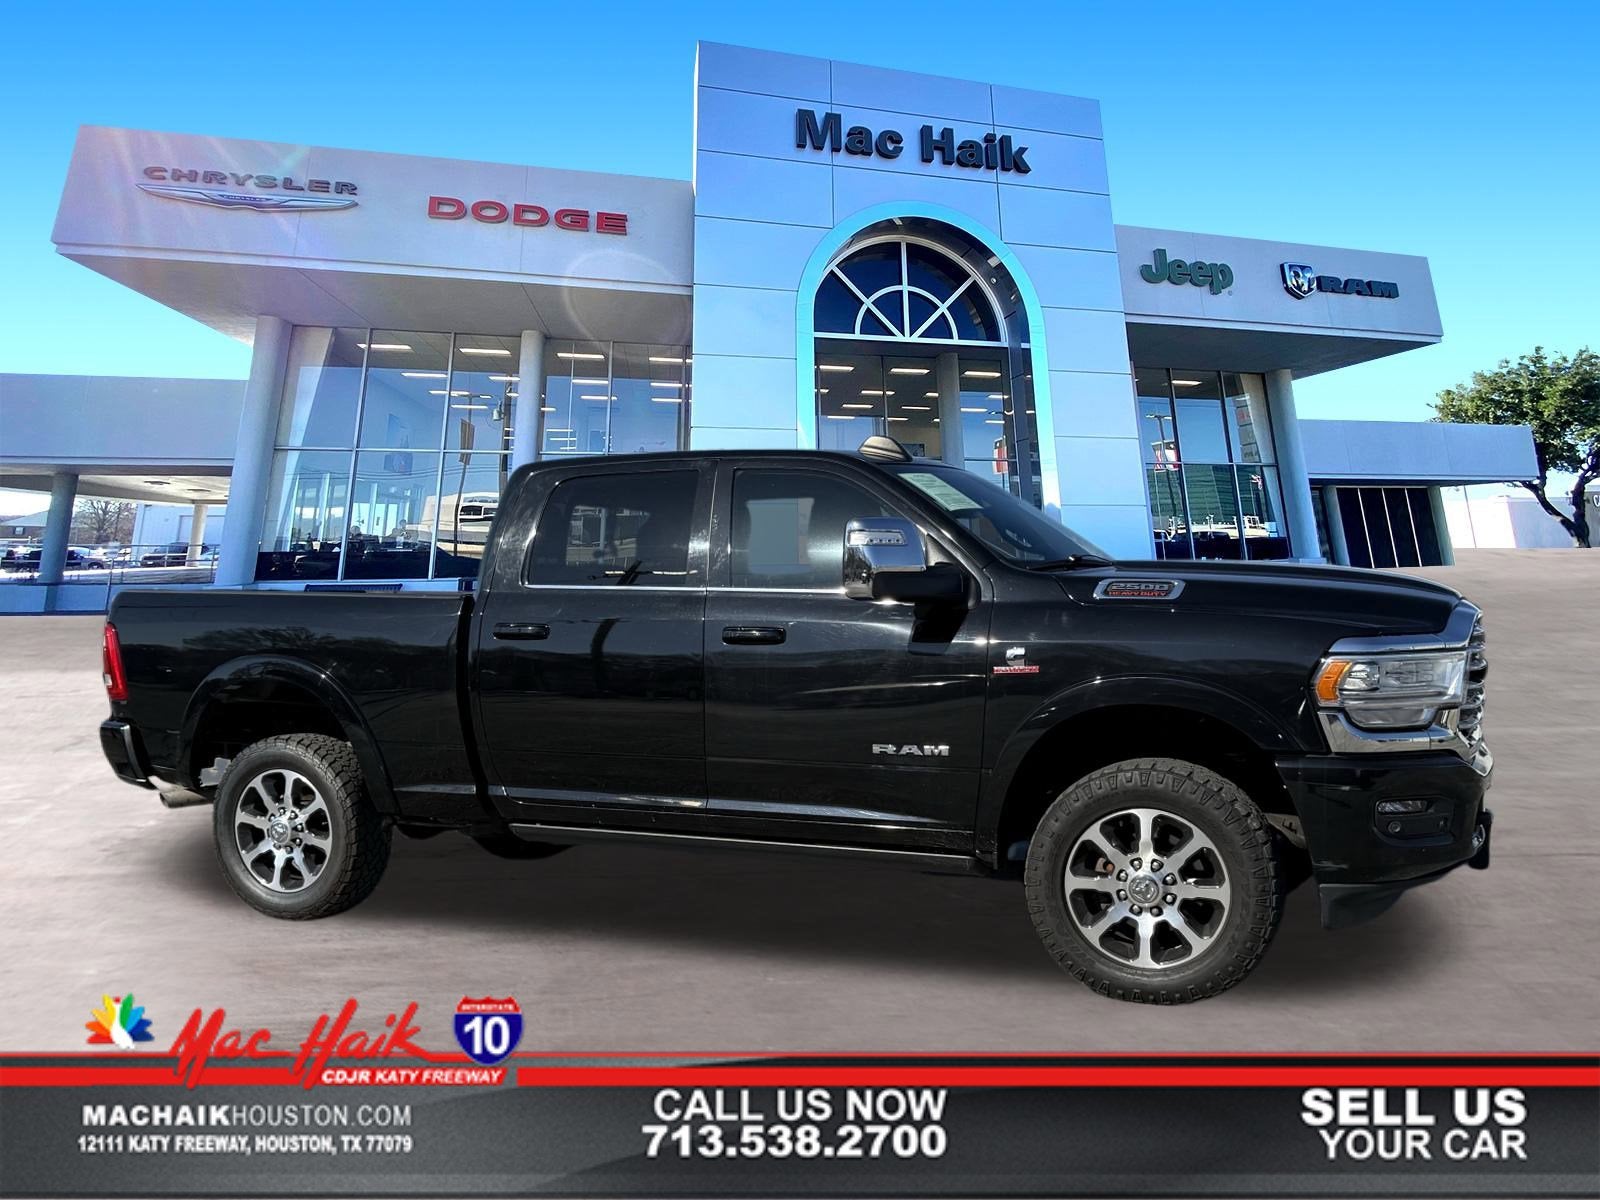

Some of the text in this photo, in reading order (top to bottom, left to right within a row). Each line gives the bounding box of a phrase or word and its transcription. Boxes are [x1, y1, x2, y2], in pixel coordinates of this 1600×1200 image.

[796, 108, 1032, 175] Mac Haik
[143, 166, 359, 196] CHRYSLER
[428, 196, 628, 236] DODGE
[1139, 248, 1235, 296] Jeep
[1316, 275, 1400, 299] RAM
[1111, 582, 1169, 590] 2500
[872, 743, 950, 757] RAM
